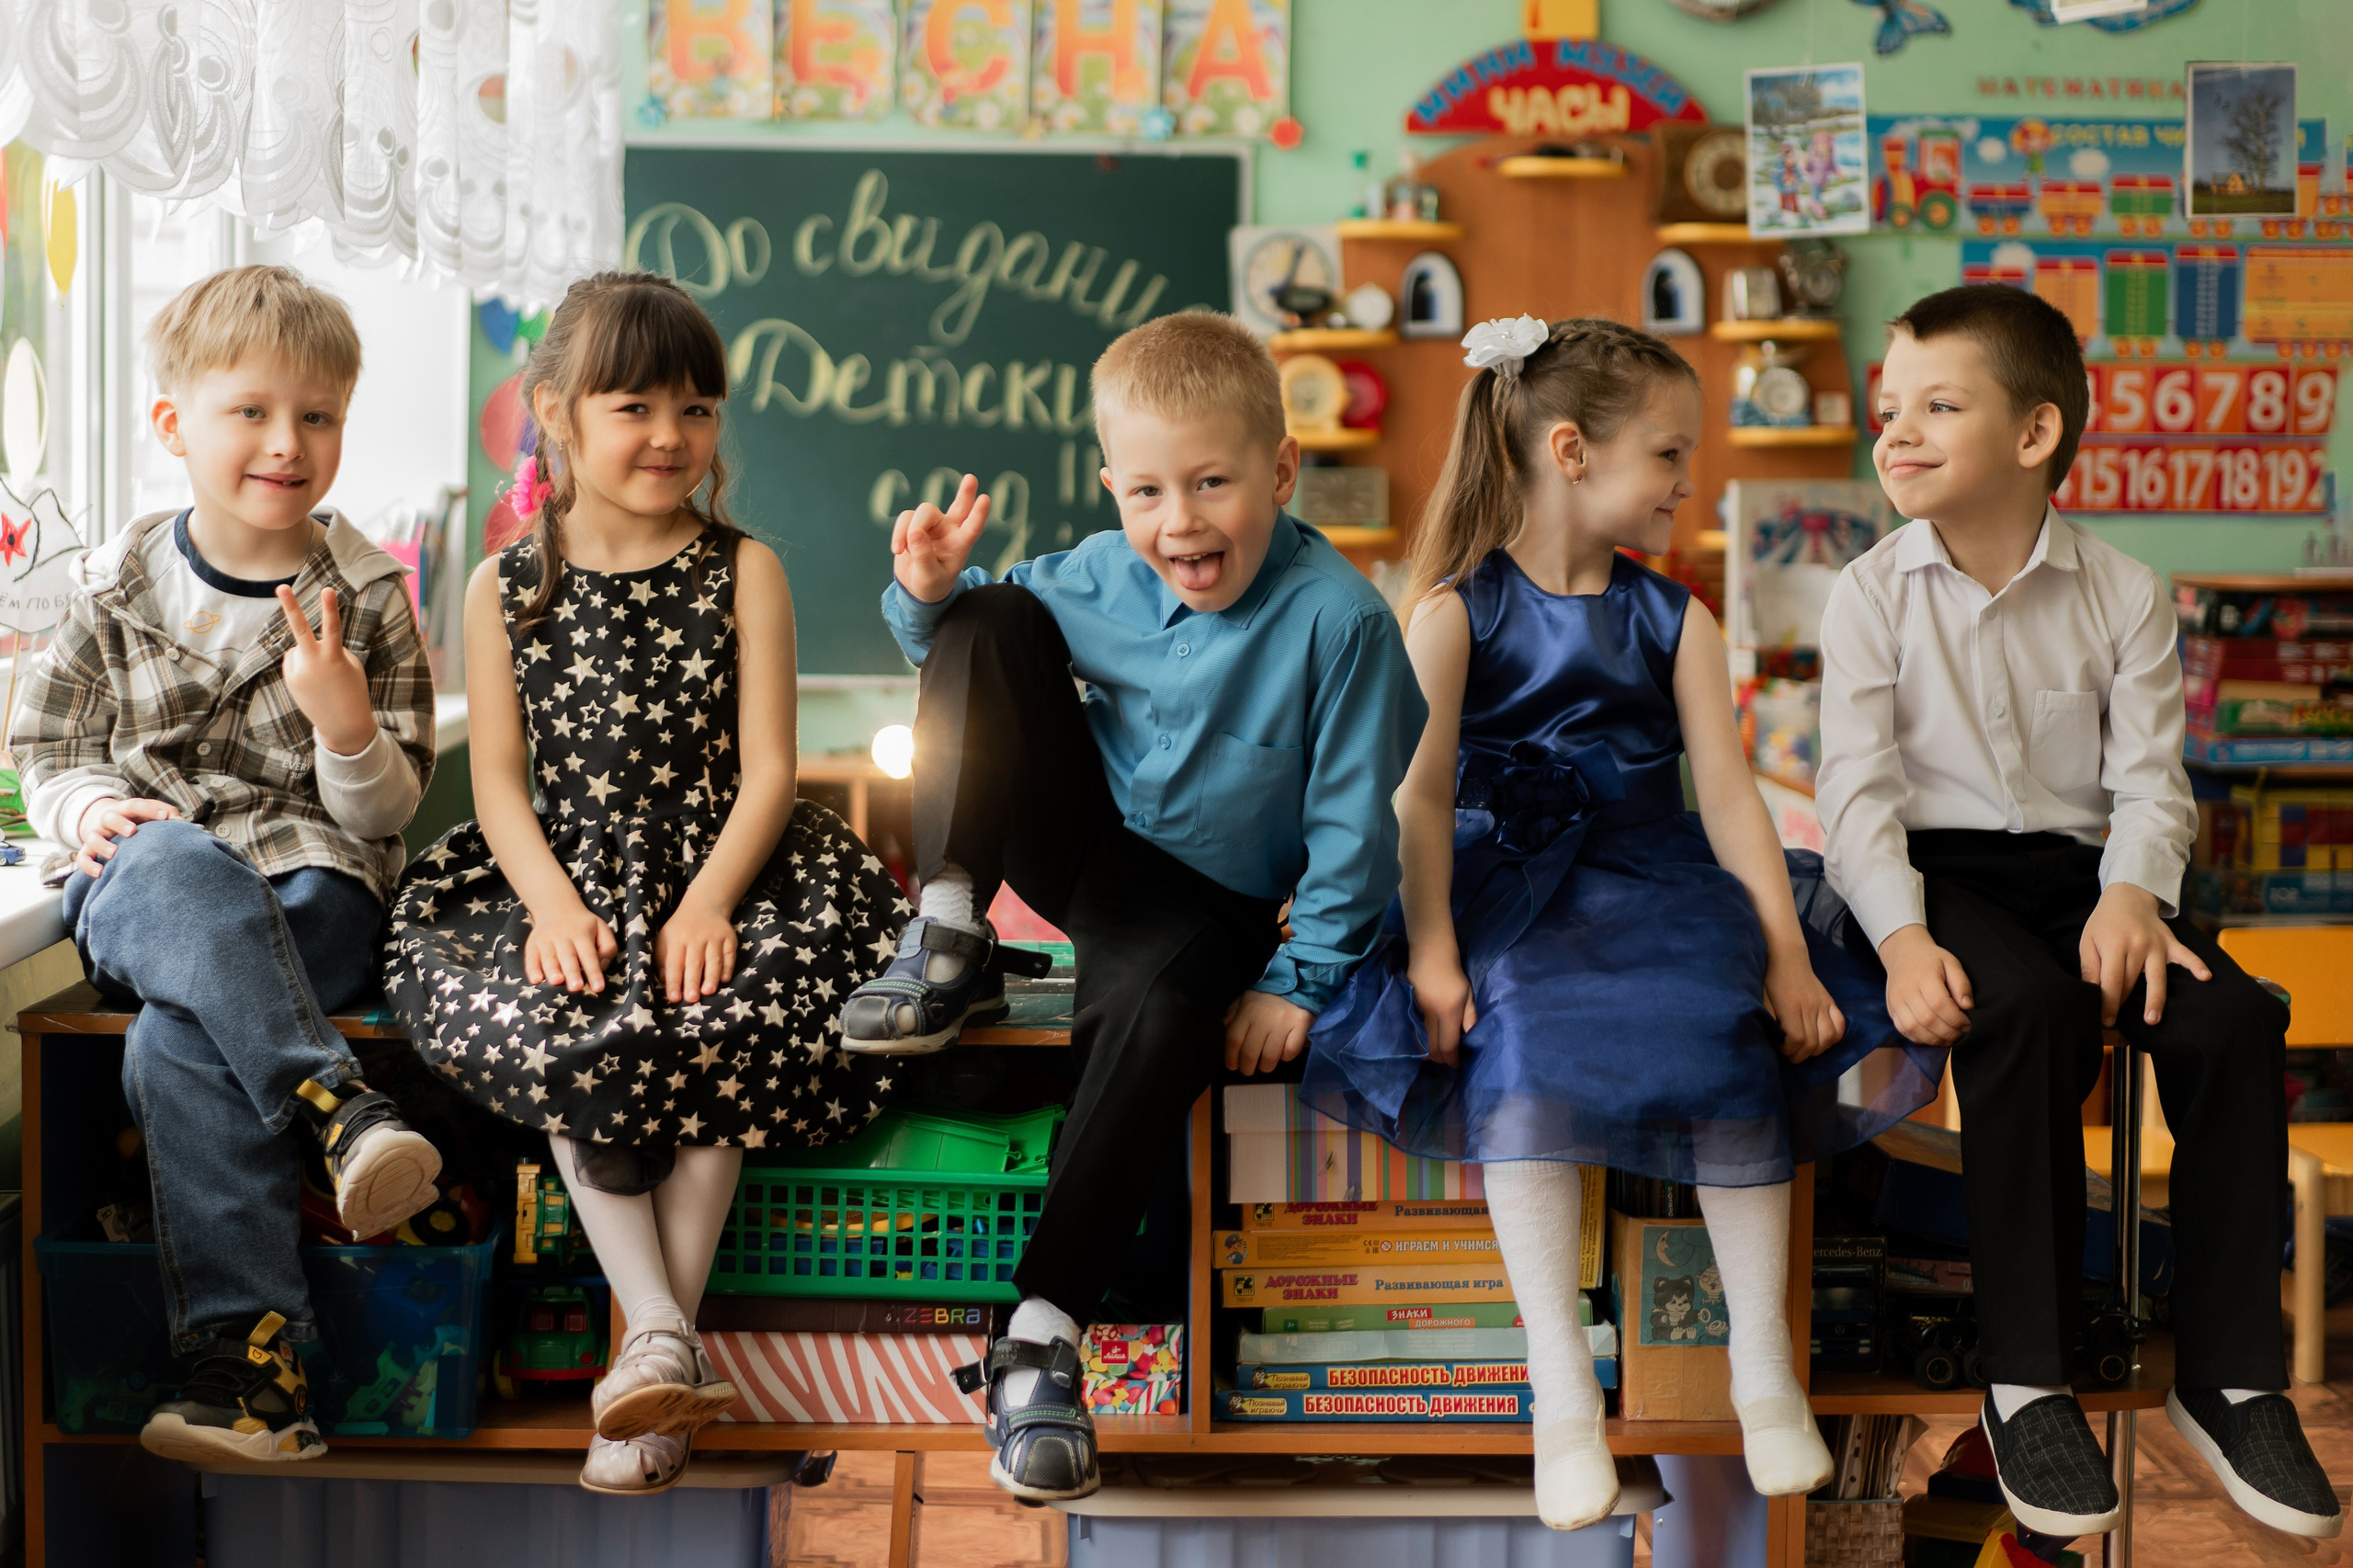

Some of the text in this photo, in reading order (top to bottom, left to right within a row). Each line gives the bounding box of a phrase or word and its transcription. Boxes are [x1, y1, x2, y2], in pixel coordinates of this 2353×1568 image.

[666, 0, 1276, 99] ВЕСНА
[1976, 75, 2186, 100] МАТЕМАТИКА
[1487, 82, 1631, 136] ЧАСЫ
[624, 169, 1172, 347] До свидани
[730, 317, 1093, 432] Детски
[2109, 369, 2146, 432] 5
[2154, 369, 2196, 432] 6
[2203, 369, 2241, 432] 7
[2248, 369, 2287, 432] 8
[2297, 370, 2336, 432] 9
[2078, 448, 2121, 507] 15
[2122, 448, 2167, 507] 16
[2168, 449, 2213, 508] 17
[2216, 448, 2260, 508] 18
[2263, 449, 2307, 508] 19
[1285, 1201, 1489, 1217] ДОРОЖНЫЕ Развивающая
[1302, 1213, 1358, 1225] ЗНАКИ
[1395, 1239, 1500, 1252] ИГРАЕМ И УЧИМСЯ
[1813, 1245, 1882, 1257] ercedes-Benz
[1265, 1274, 1504, 1291] ДОРОЖНЫЕ Развивающая игра
[1282, 1288, 1338, 1300] ЗНАКИ
[904, 1307, 980, 1324] ZEBRA
[1392, 1309, 1428, 1320] ЗНАКИ
[1415, 1319, 1471, 1327] ДОРОЖНОГО
[1272, 1373, 1309, 1382] Познавай
[1328, 1364, 1529, 1387] БЕЗОПАСНОСТЬ ДВИЖЕНИ
[1247, 1398, 1286, 1407] Познавай
[1250, 1406, 1285, 1415] играючи
[1304, 1394, 1518, 1417] БЕЗОПАСНОСТЬ ДВИЖЕНИЯ
